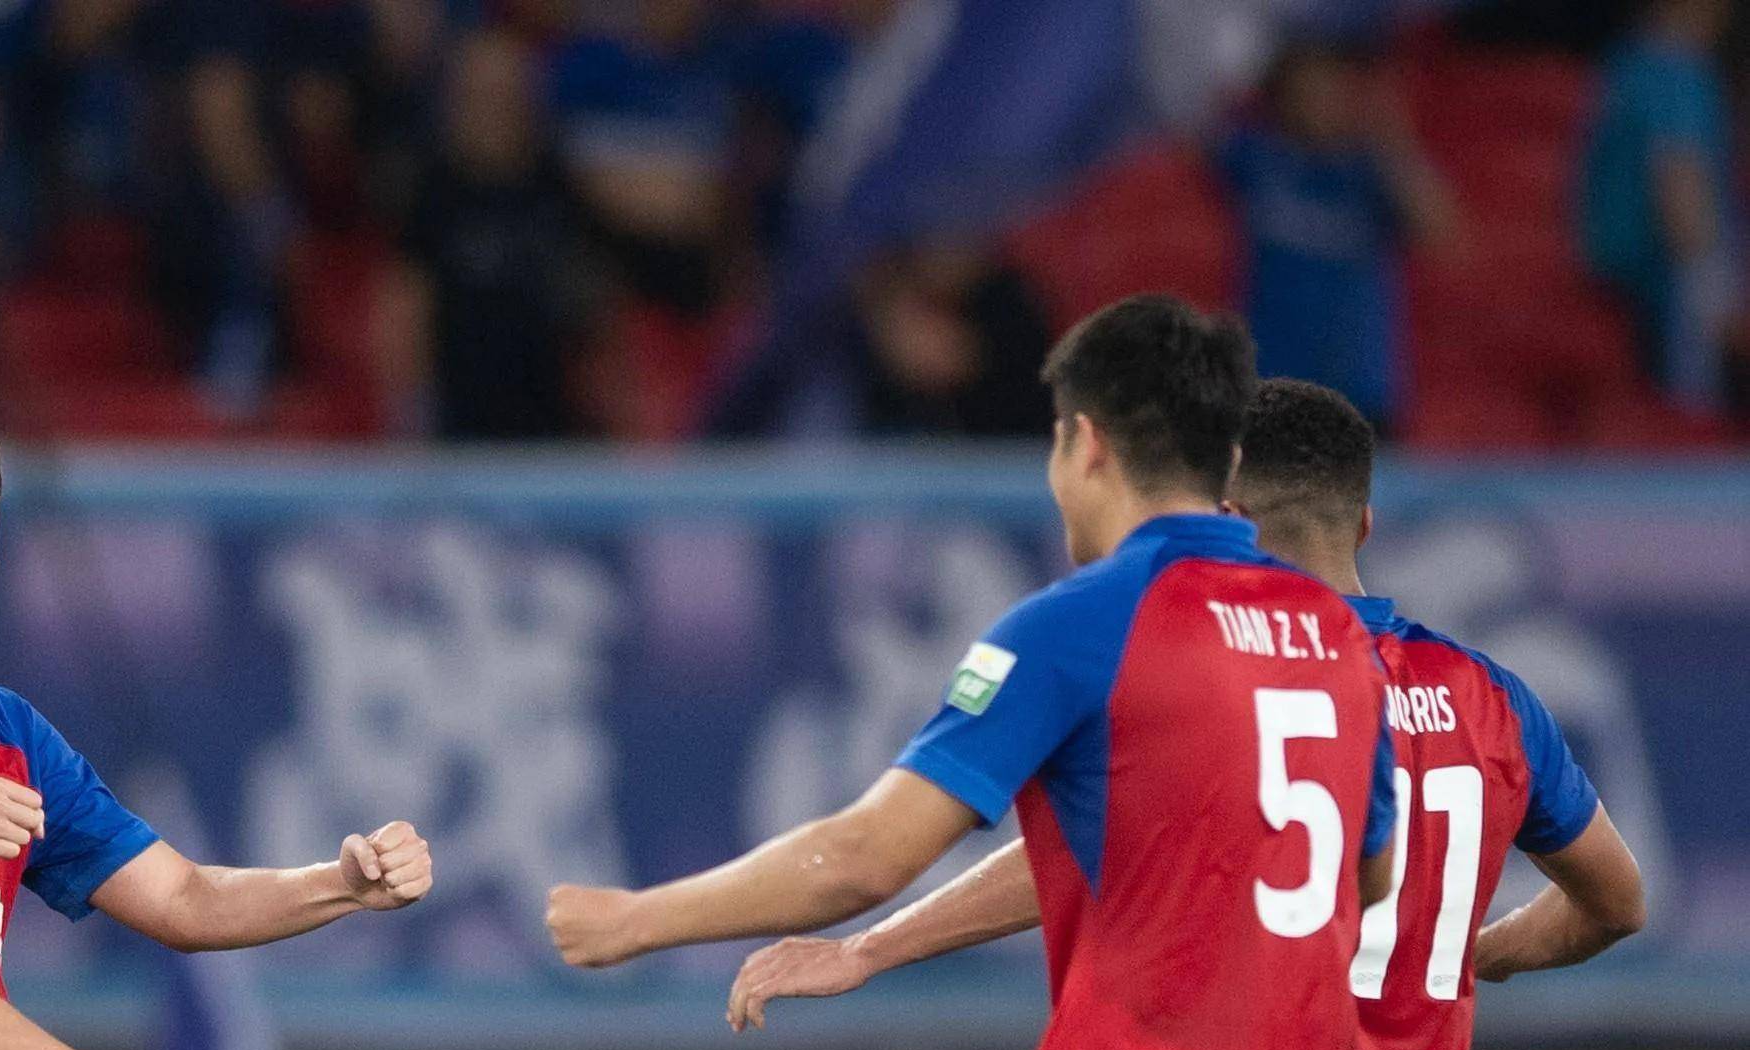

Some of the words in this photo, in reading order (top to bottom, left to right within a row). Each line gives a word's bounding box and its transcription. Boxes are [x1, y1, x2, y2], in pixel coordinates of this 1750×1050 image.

[1207, 600, 1275, 656] TIAN
[1273, 610, 1339, 660] Z.Y.
[1253, 688, 1344, 939] 5
